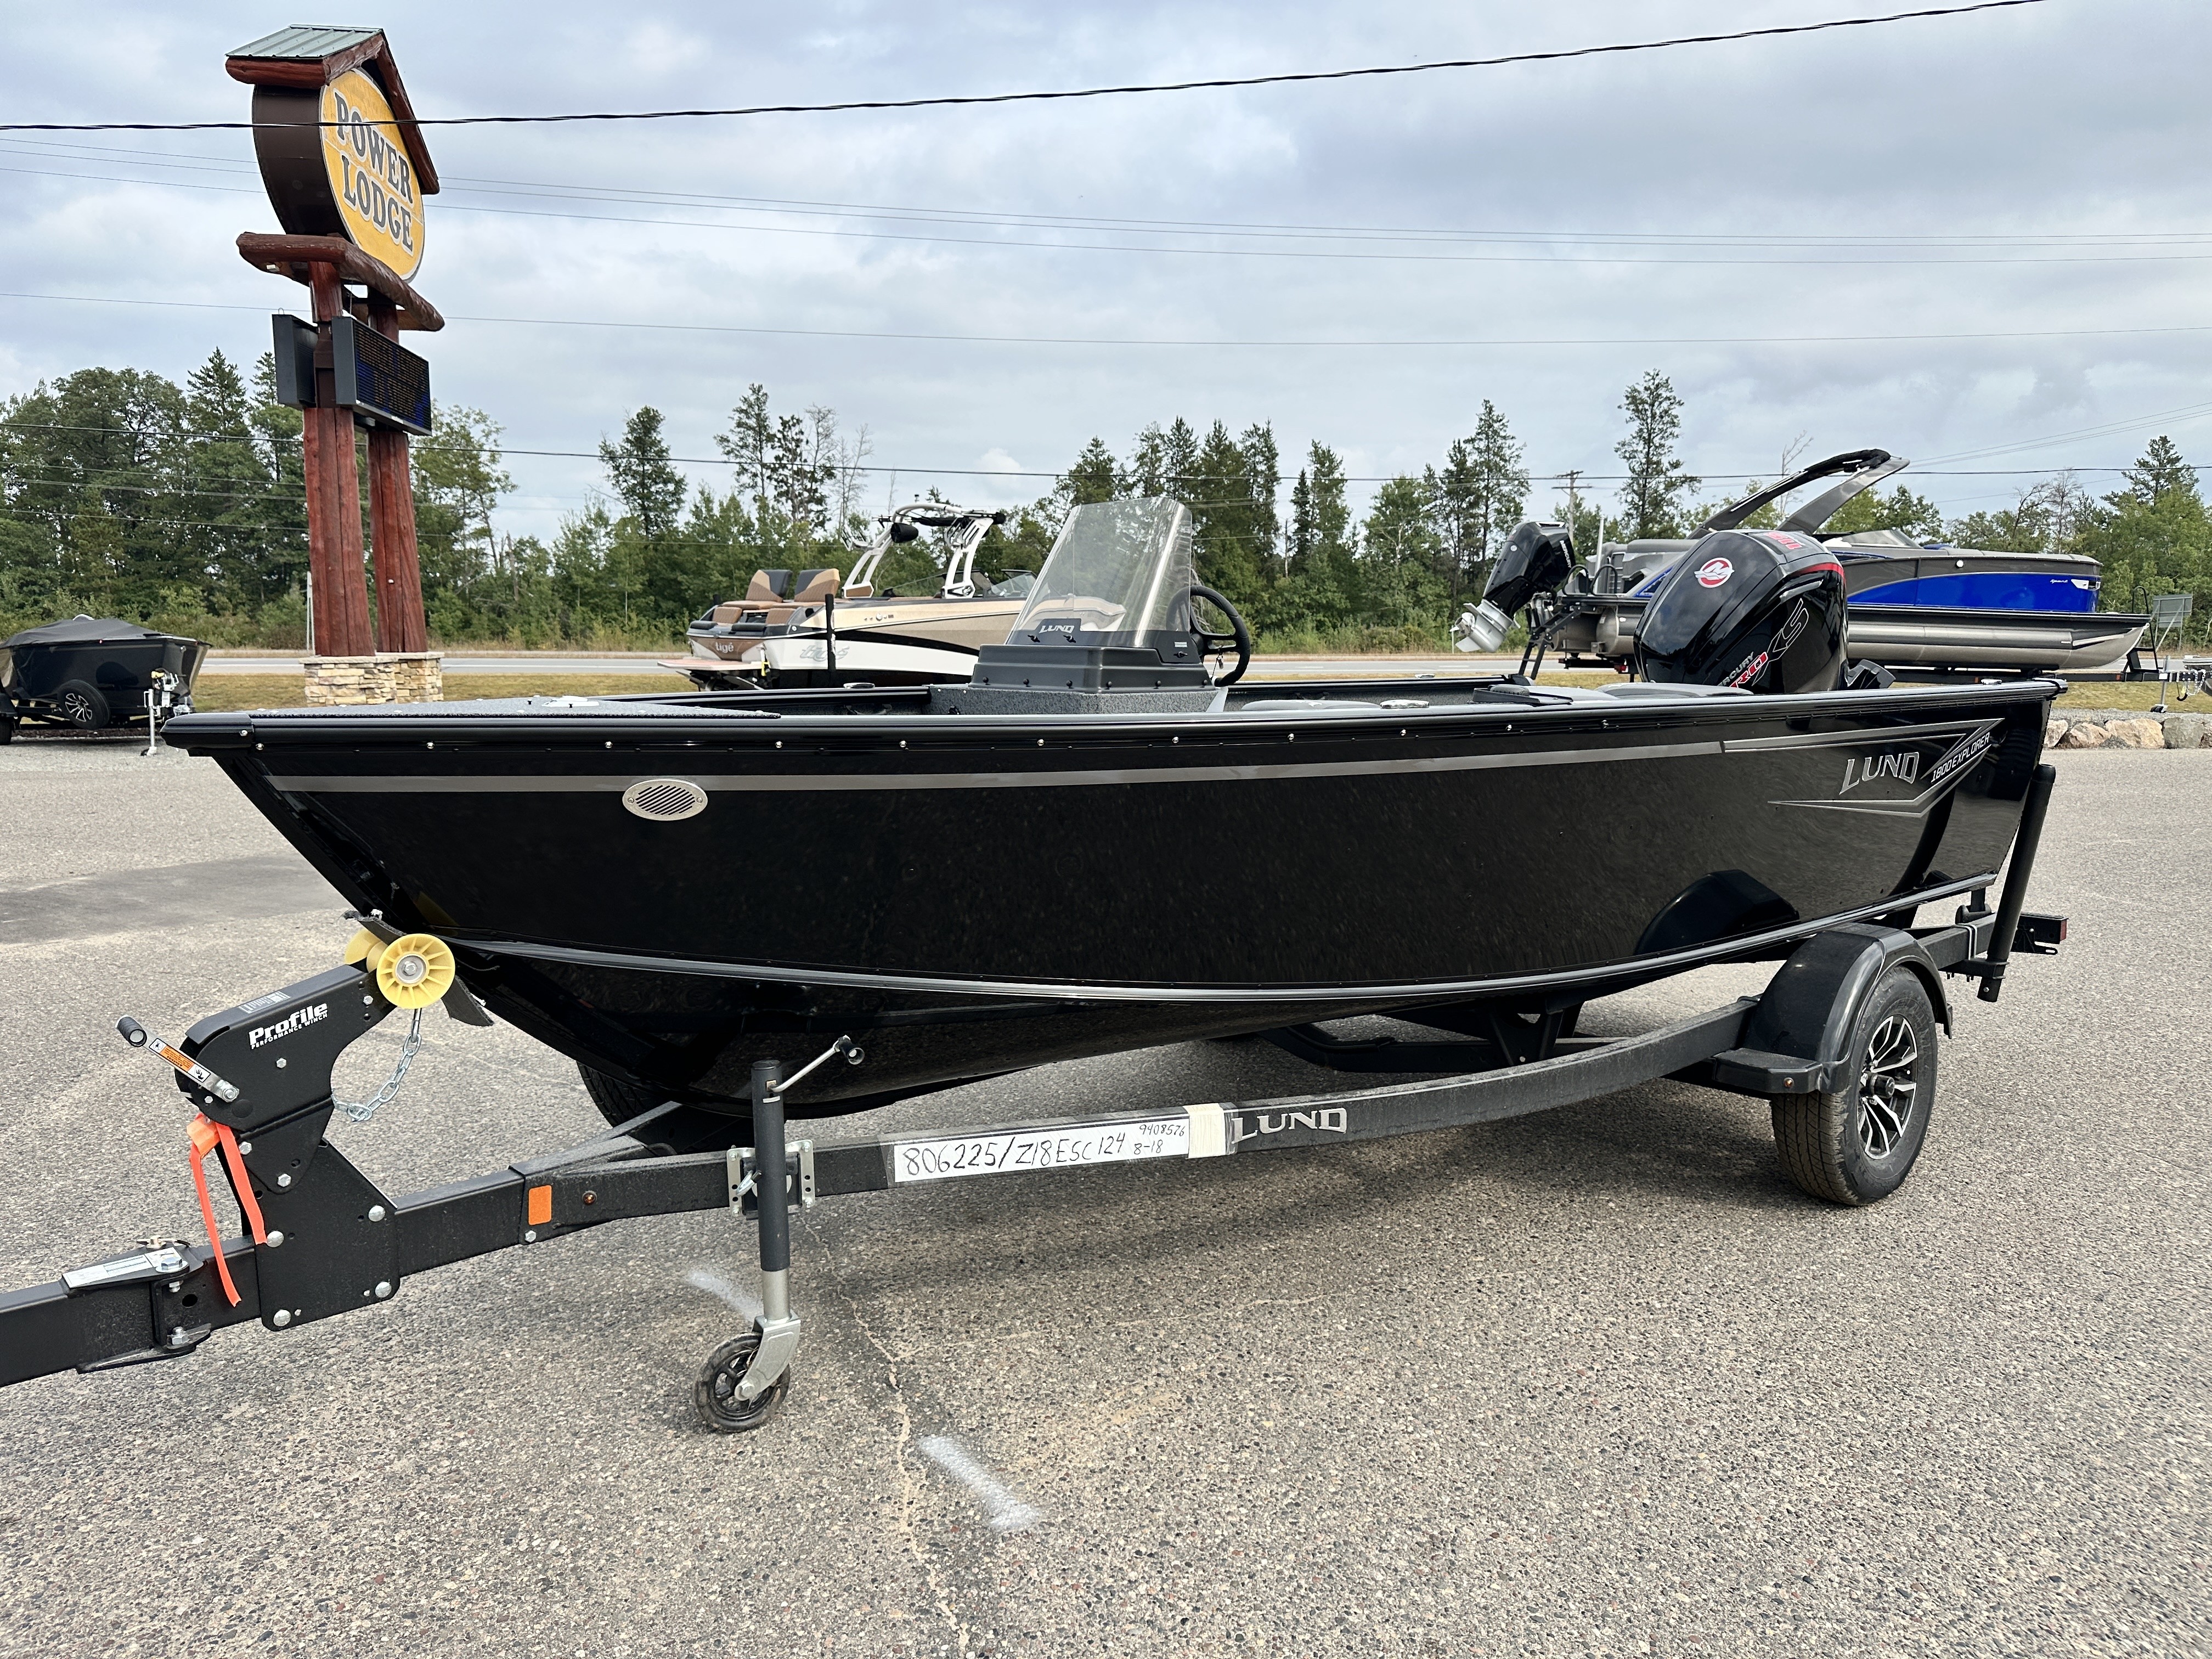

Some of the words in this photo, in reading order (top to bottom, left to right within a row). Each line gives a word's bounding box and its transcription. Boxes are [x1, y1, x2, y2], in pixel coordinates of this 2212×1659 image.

[335, 92, 413, 204] POWER
[342, 155, 413, 251] LODGE
[1560, 540, 1572, 568] MERCURY
[715, 641, 734, 653] tigé
[1039, 625, 1075, 634] LUND
[1717, 651, 1754, 686] RCURY
[1729, 651, 1768, 689] RO
[1951, 732, 1990, 769] EXPLORER
[1839, 751, 1920, 795] LUND
[249, 1003, 328, 1046] Profile
[251, 1023, 302, 1049] PERFORMANCE
[304, 1012, 328, 1027] WINCH
[1139, 1124, 1186, 1137] 9408576
[1231, 1107, 1347, 1144] LUND
[1133, 1139, 1163, 1155] 8-18
